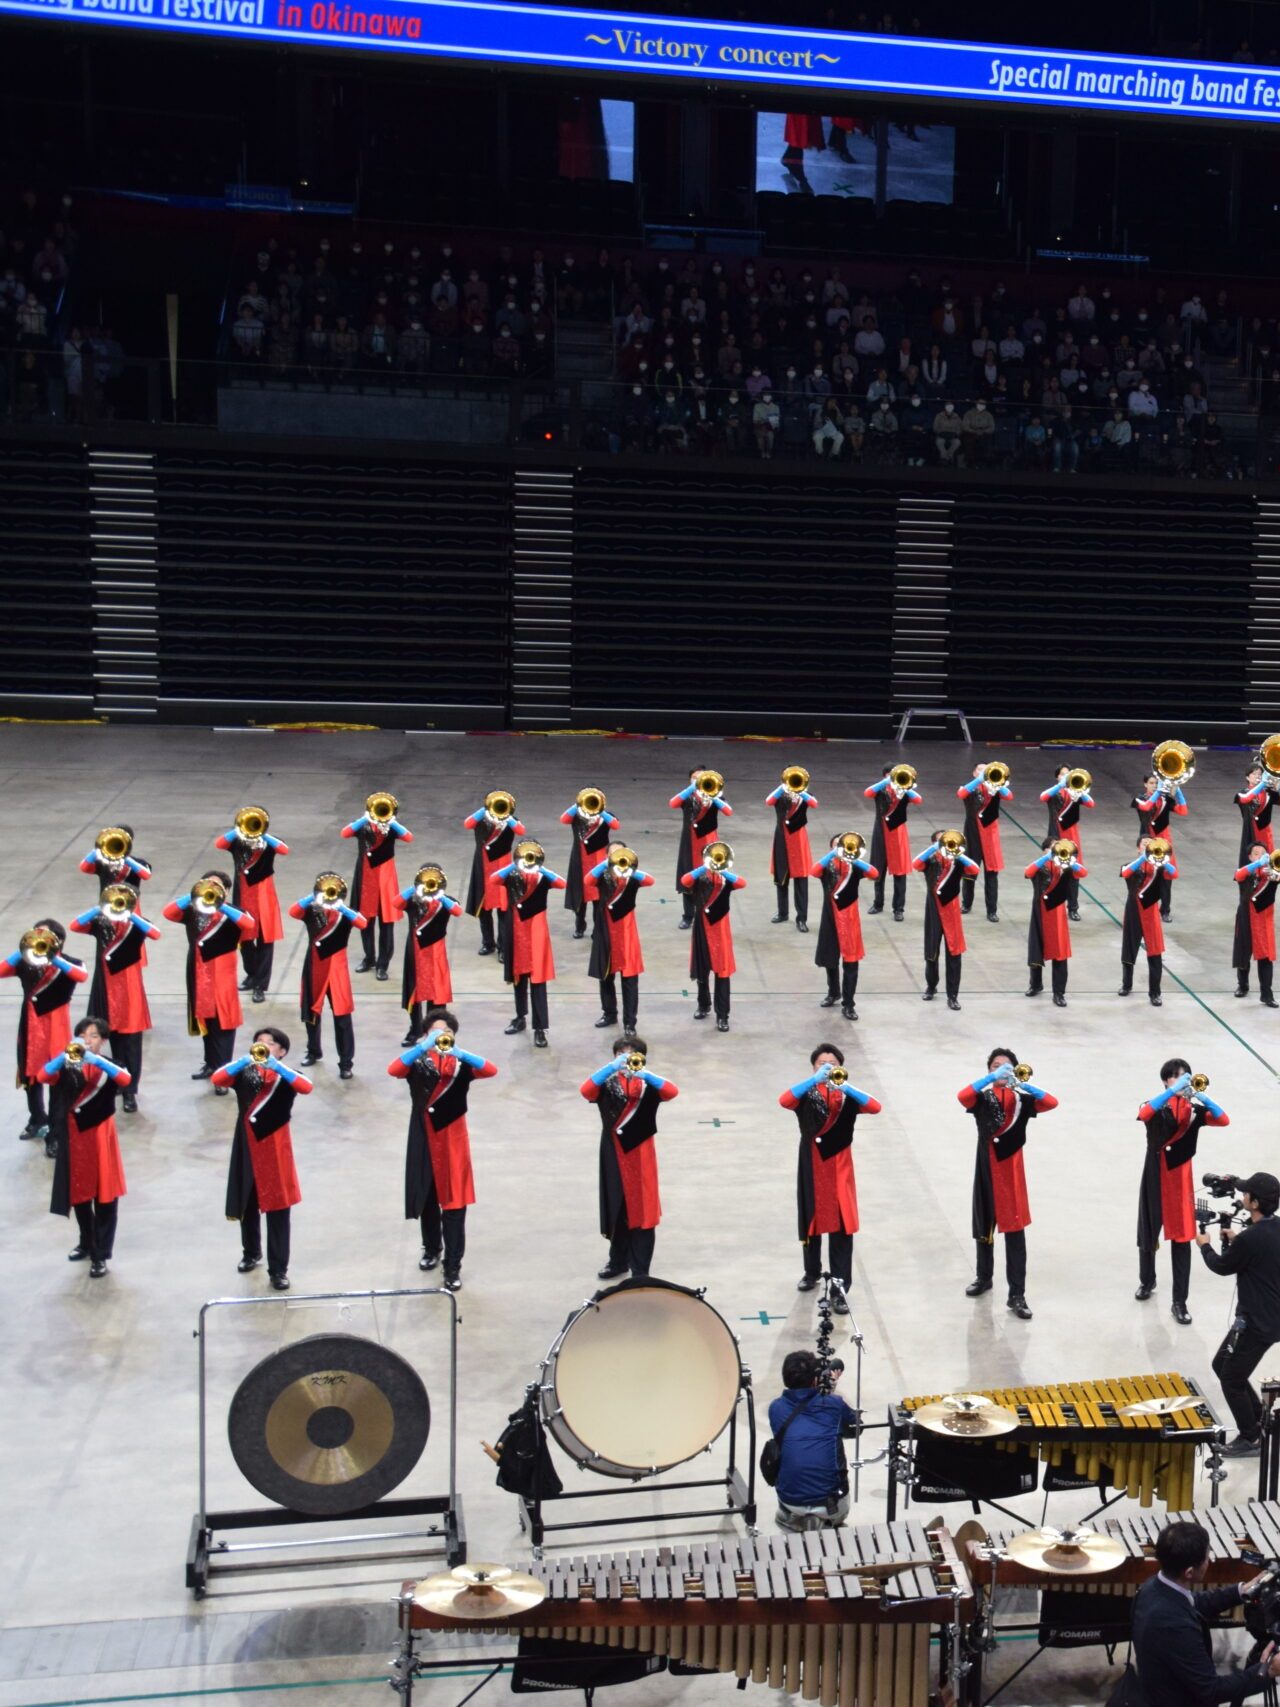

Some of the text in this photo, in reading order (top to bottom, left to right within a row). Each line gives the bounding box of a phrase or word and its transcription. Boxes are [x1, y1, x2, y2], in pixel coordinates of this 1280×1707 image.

[278, 0, 302, 27] in
[310, 2, 421, 38] Okinawa
[989, 59, 1071, 92] Special
[1075, 69, 1185, 106] marching
[1190, 74, 1249, 104] band
[1049, 1629, 1102, 1639] POMARK
